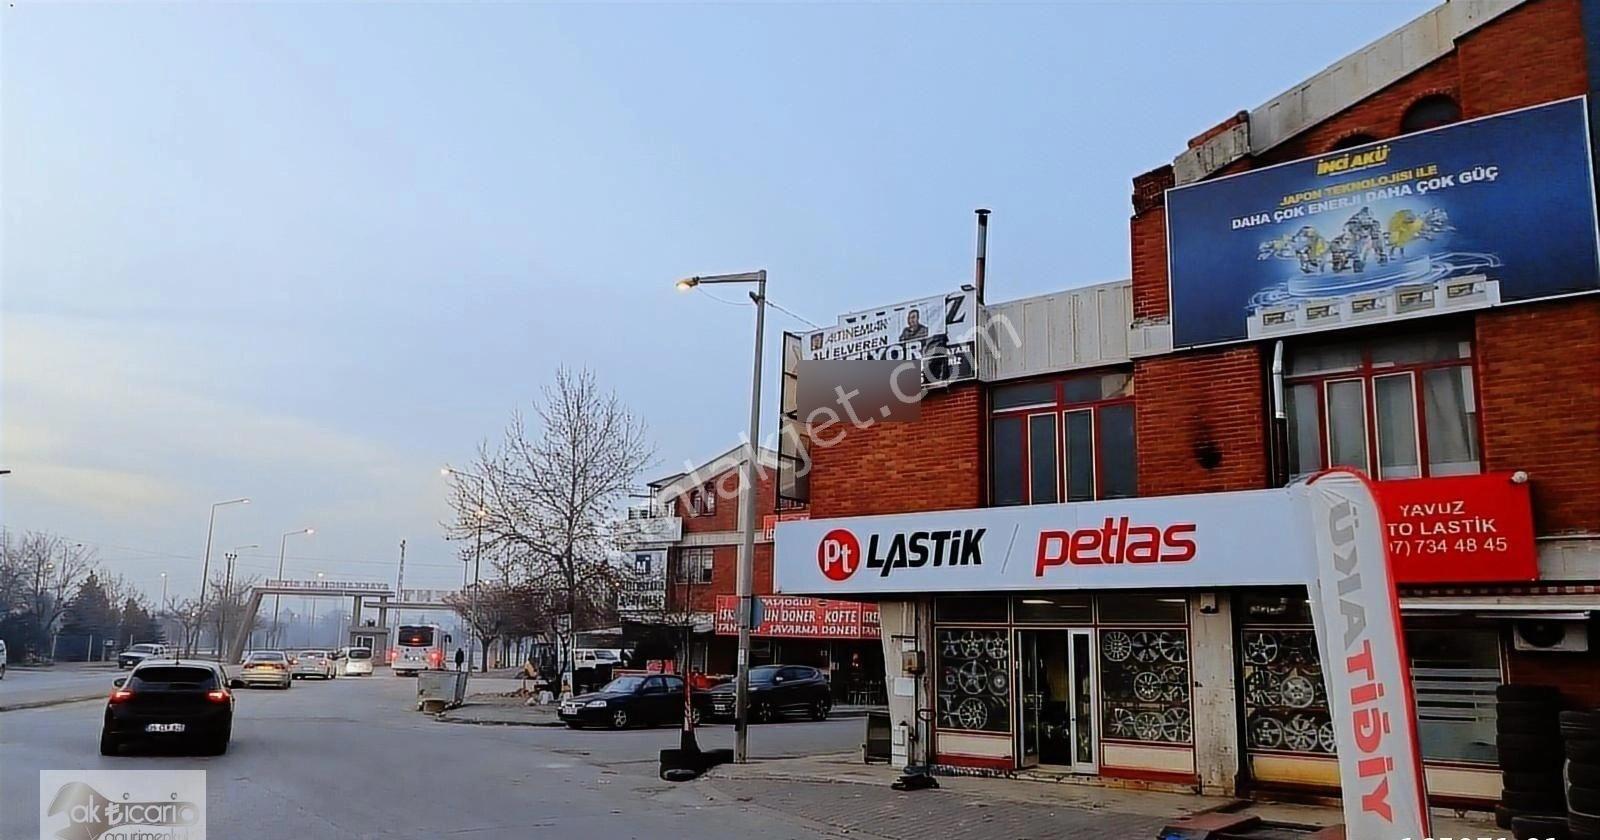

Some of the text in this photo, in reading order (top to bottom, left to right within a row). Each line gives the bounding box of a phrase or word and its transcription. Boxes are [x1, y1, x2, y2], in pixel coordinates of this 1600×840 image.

[1232, 213, 1270, 229] DAHA
[1274, 207, 1305, 223] ÇOK
[1365, 184, 1412, 202] DAHA
[1416, 174, 1455, 194] ÇOK
[1459, 166, 1499, 183] GÜÇ
[1280, 189, 1322, 206] JAPON
[833, 336, 888, 357] ELVEREN
[1400, 500, 1465, 517] YAVUZ
[1387, 516, 1497, 536] TO LASTİK
[823, 538, 852, 574] Pt
[1035, 517, 1197, 577] petlas
[1414, 539, 1447, 554] 734
[1454, 538, 1477, 553] 48
[1484, 537, 1507, 552] 45
